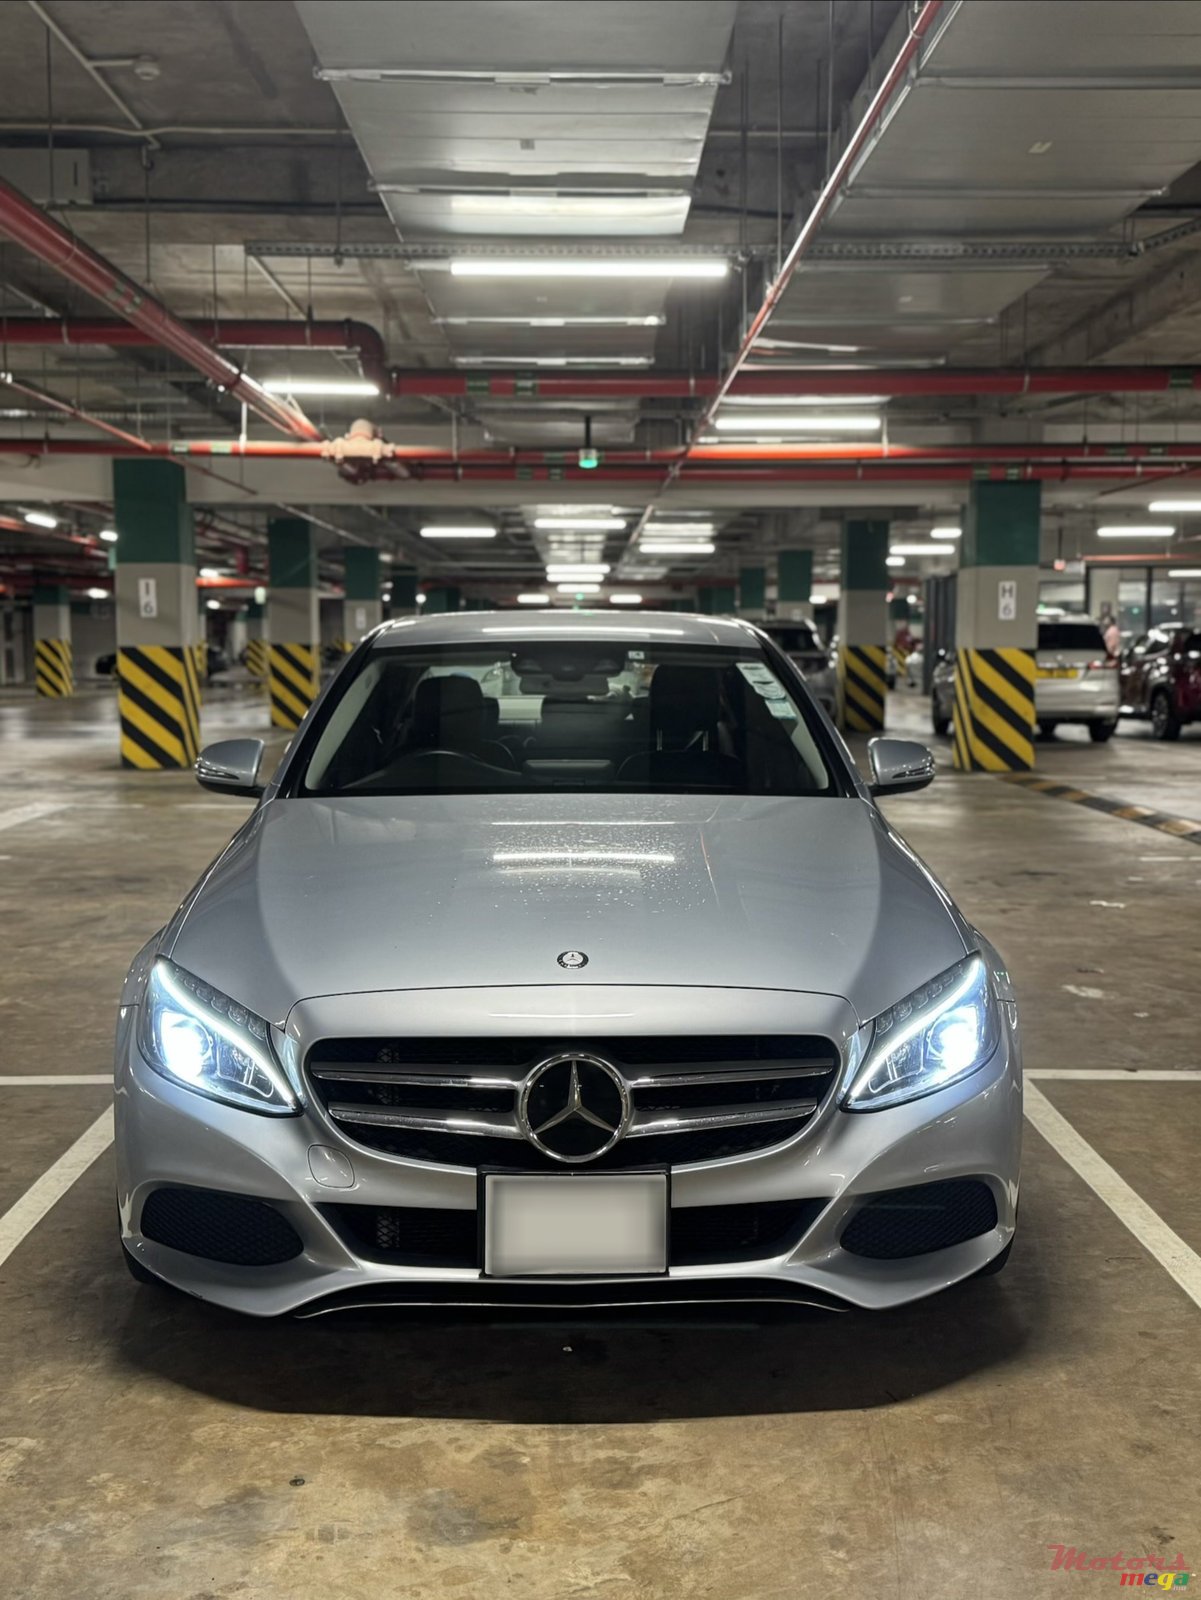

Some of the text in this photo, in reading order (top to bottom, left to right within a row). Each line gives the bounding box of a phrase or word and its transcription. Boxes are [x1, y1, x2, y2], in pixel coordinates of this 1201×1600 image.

[1002, 584, 1013, 598] H
[143, 601, 153, 614] 6
[1002, 603, 1012, 616] 6
